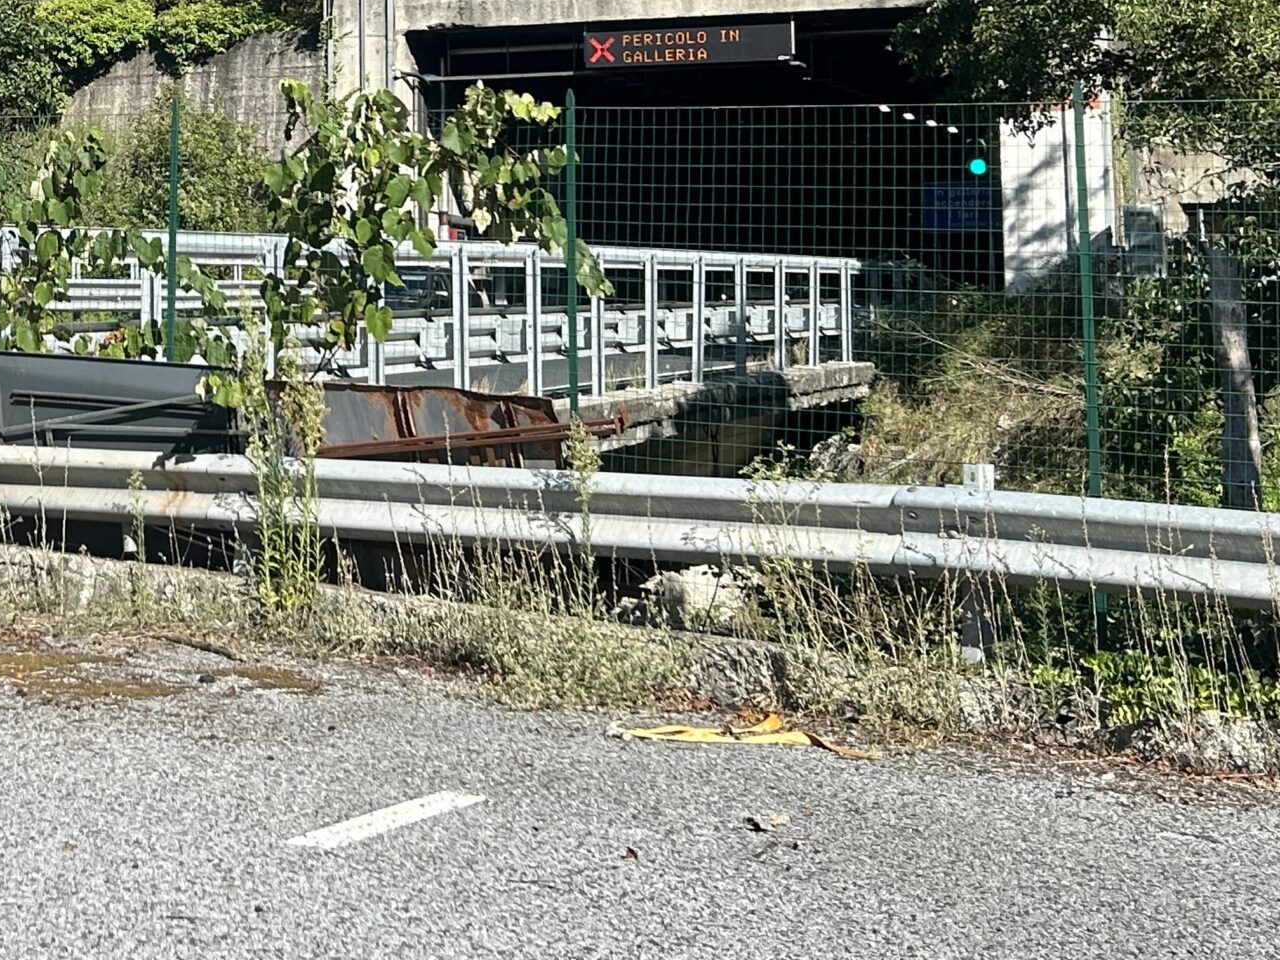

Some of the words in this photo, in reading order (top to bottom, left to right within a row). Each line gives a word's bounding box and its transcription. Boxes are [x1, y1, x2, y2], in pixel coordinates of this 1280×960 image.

[622, 31, 707, 46] PERICOLO
[720, 29, 740, 43] IN
[622, 47, 708, 64] GALLERIA
